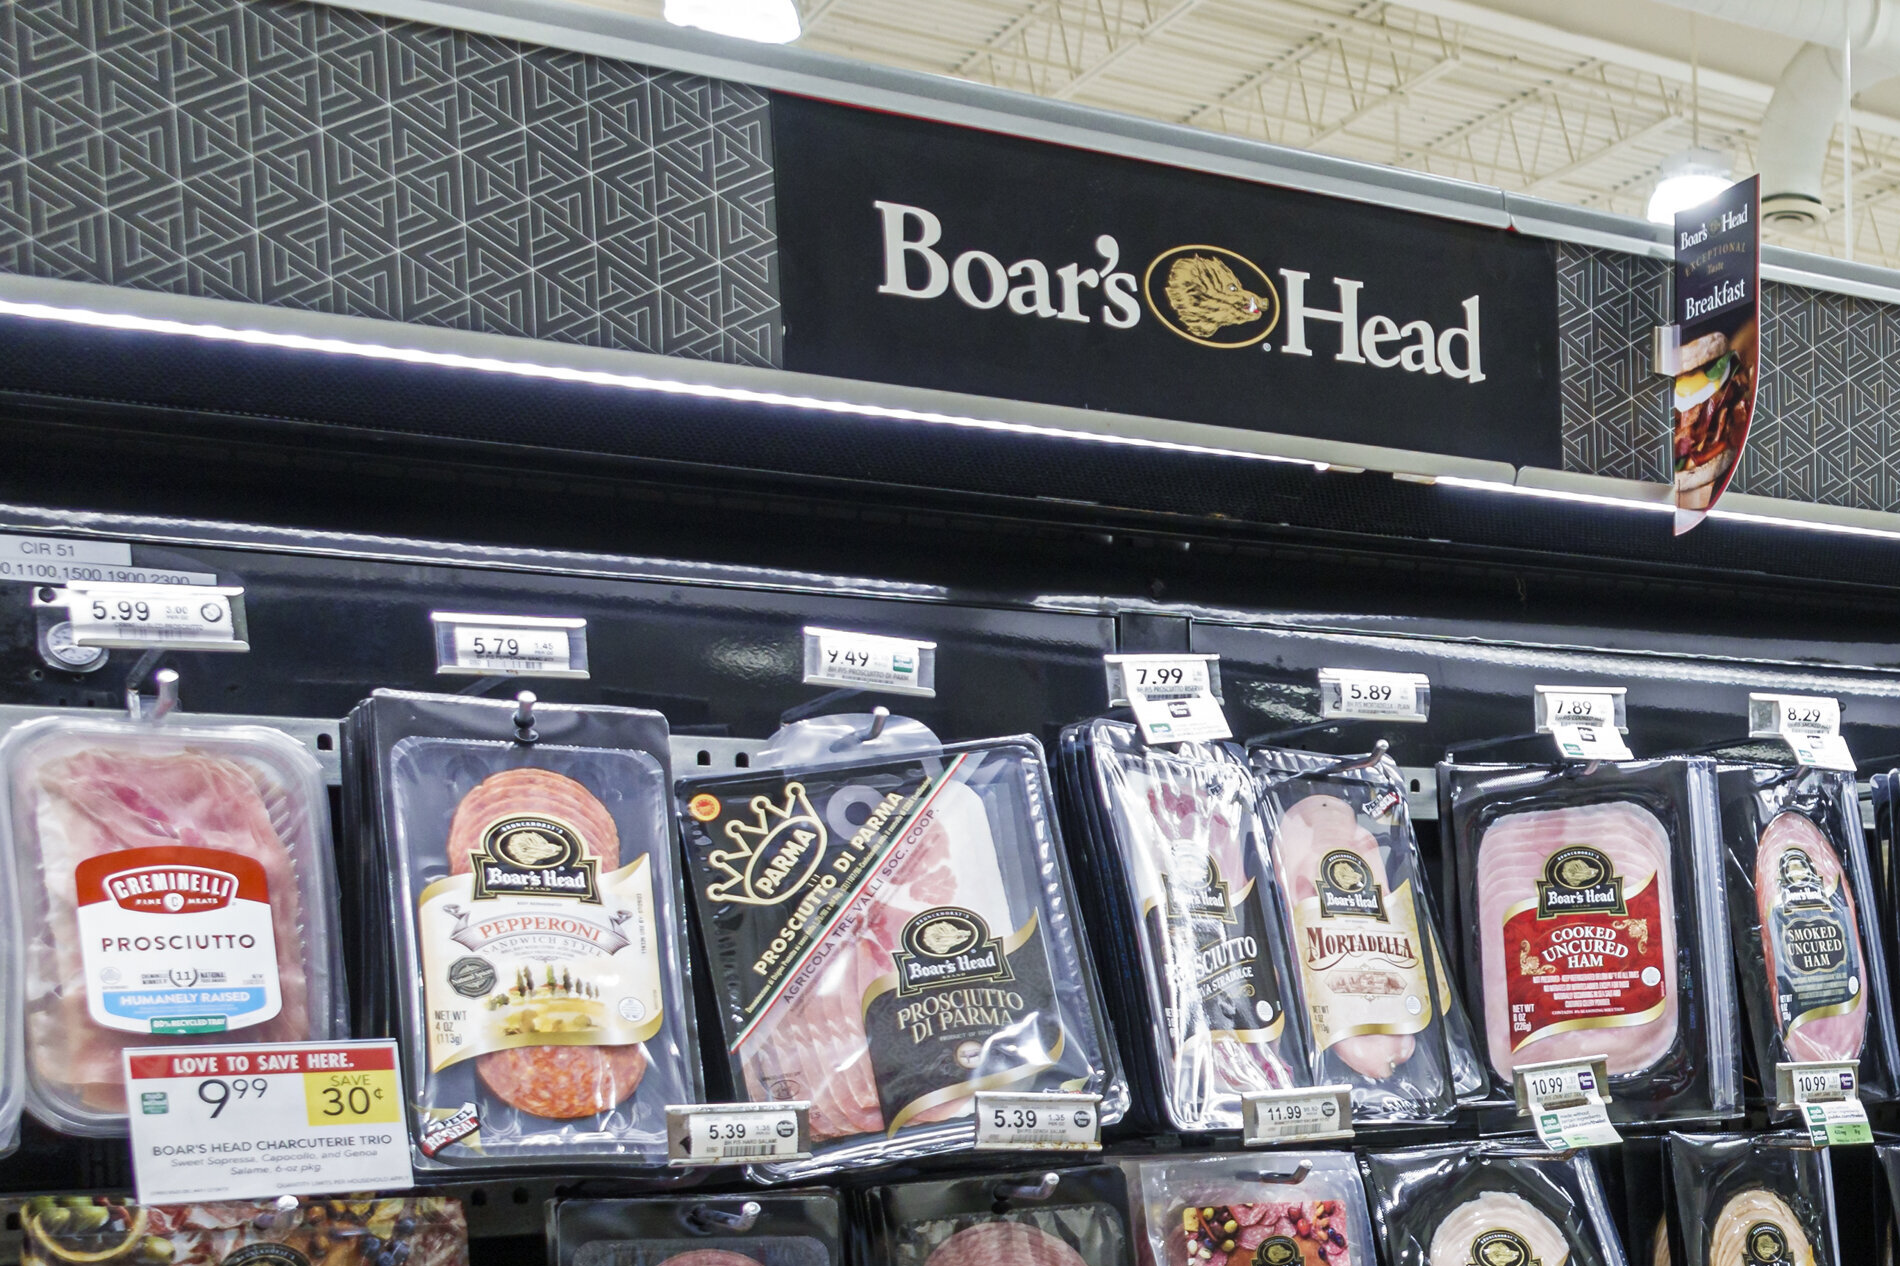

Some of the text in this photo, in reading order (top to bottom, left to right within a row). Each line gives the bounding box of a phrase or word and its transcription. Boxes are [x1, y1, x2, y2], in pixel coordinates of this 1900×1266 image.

[1680, 203, 1748, 251] Boar's Head
[1685, 242, 1746, 277] EXCEPTIONAL
[1707, 262, 1724, 275] Taste
[872, 199, 1487, 386] Boar's Head
[1686, 278, 1745, 320] Breakfast
[21, 542, 76, 557] CIR 51
[92, 601, 150, 621] 5.99
[473, 637, 520, 656] 5.79
[827, 649, 869, 666] 9.49
[1136, 668, 1183, 685] 7.99
[1350, 684, 1392, 700] 5.89
[1556, 701, 1592, 715] 7.89
[1788, 707, 1821, 722] 8.29
[754, 830, 817, 896] PARMA
[113, 869, 232, 898] CREMINELLI
[487, 866, 587, 888] Boar's Head
[753, 791, 903, 976] PROSCIUTTO DI PARMA
[783, 808, 941, 1003] AGRICOLA TRE VALLI SOC. COOP.
[479, 916, 602, 942] PEPPERONI
[1551, 926, 1617, 944] COOKED
[1788, 925, 1837, 942] SMOKED
[101, 933, 256, 953] PROSCIUTTO
[1307, 926, 1418, 963] MORTADELLA
[1542, 940, 1629, 962] UNCURED
[1787, 939, 1842, 956] UNCURED
[1568, 953, 1604, 969] HAM
[1803, 952, 1831, 967] HAM
[120, 990, 251, 1006] HUMANELY RAISED
[434, 1010, 467, 1021] NET WT
[898, 988, 1024, 1030] PROSCIUTTO
[912, 1007, 1013, 1043] DI PARMA
[436, 1033, 462, 1046] (113g)
[173, 1050, 355, 1073] LOVE TO SAVE HERE.
[330, 1074, 372, 1087] SAVE
[152, 1133, 392, 1156] BOAR'S HEAD CHARCUTERIE TRIO
